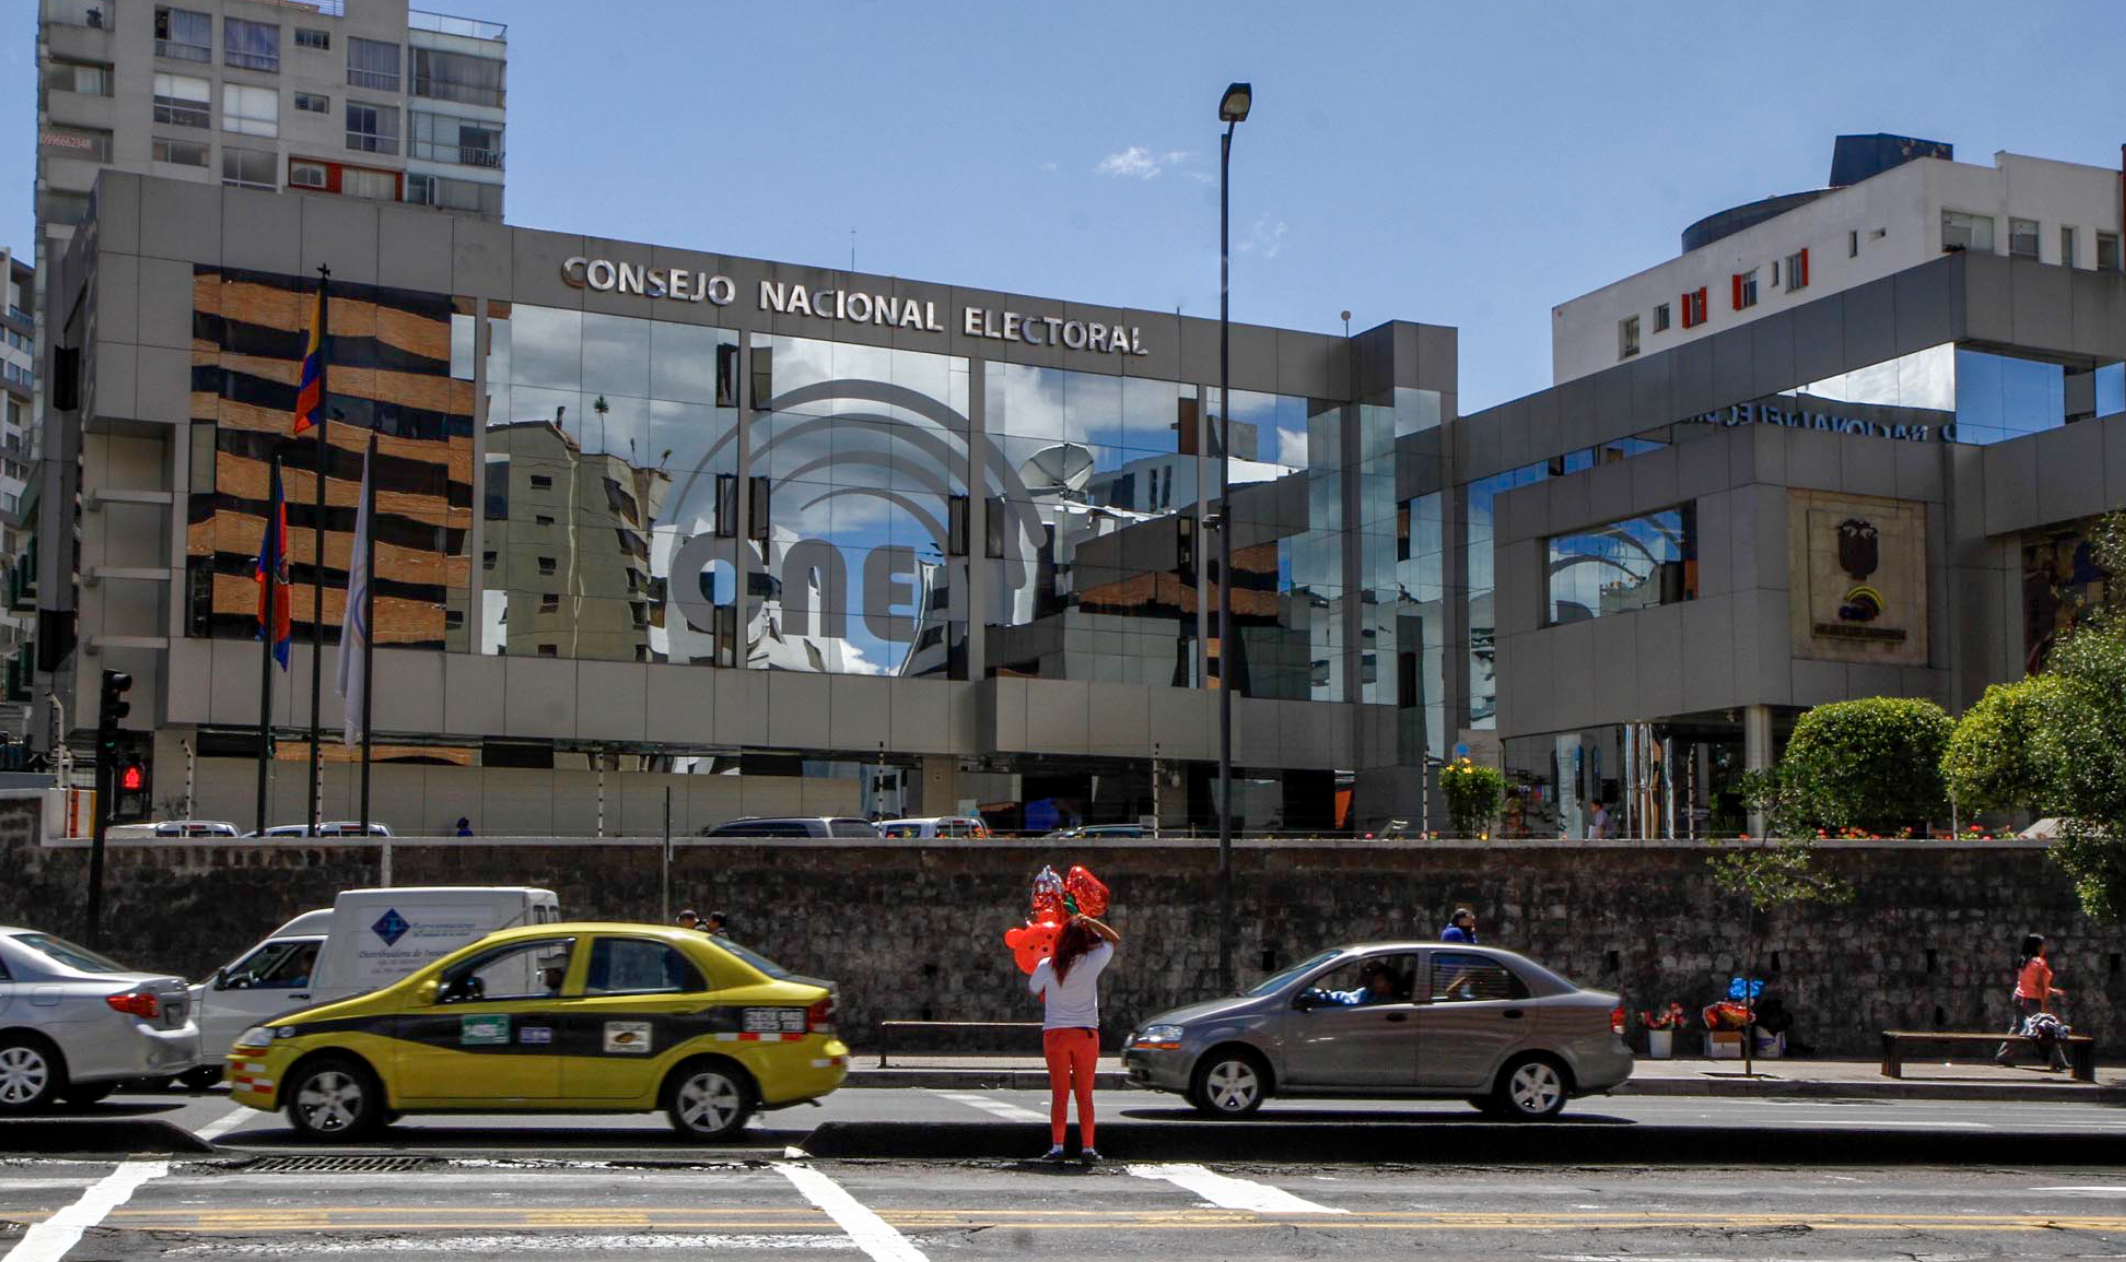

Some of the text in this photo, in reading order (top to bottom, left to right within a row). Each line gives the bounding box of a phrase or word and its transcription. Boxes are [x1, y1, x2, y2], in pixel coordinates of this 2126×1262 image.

[562, 256, 1149, 356] CONSEJO NACIONAL ELECTORAL
